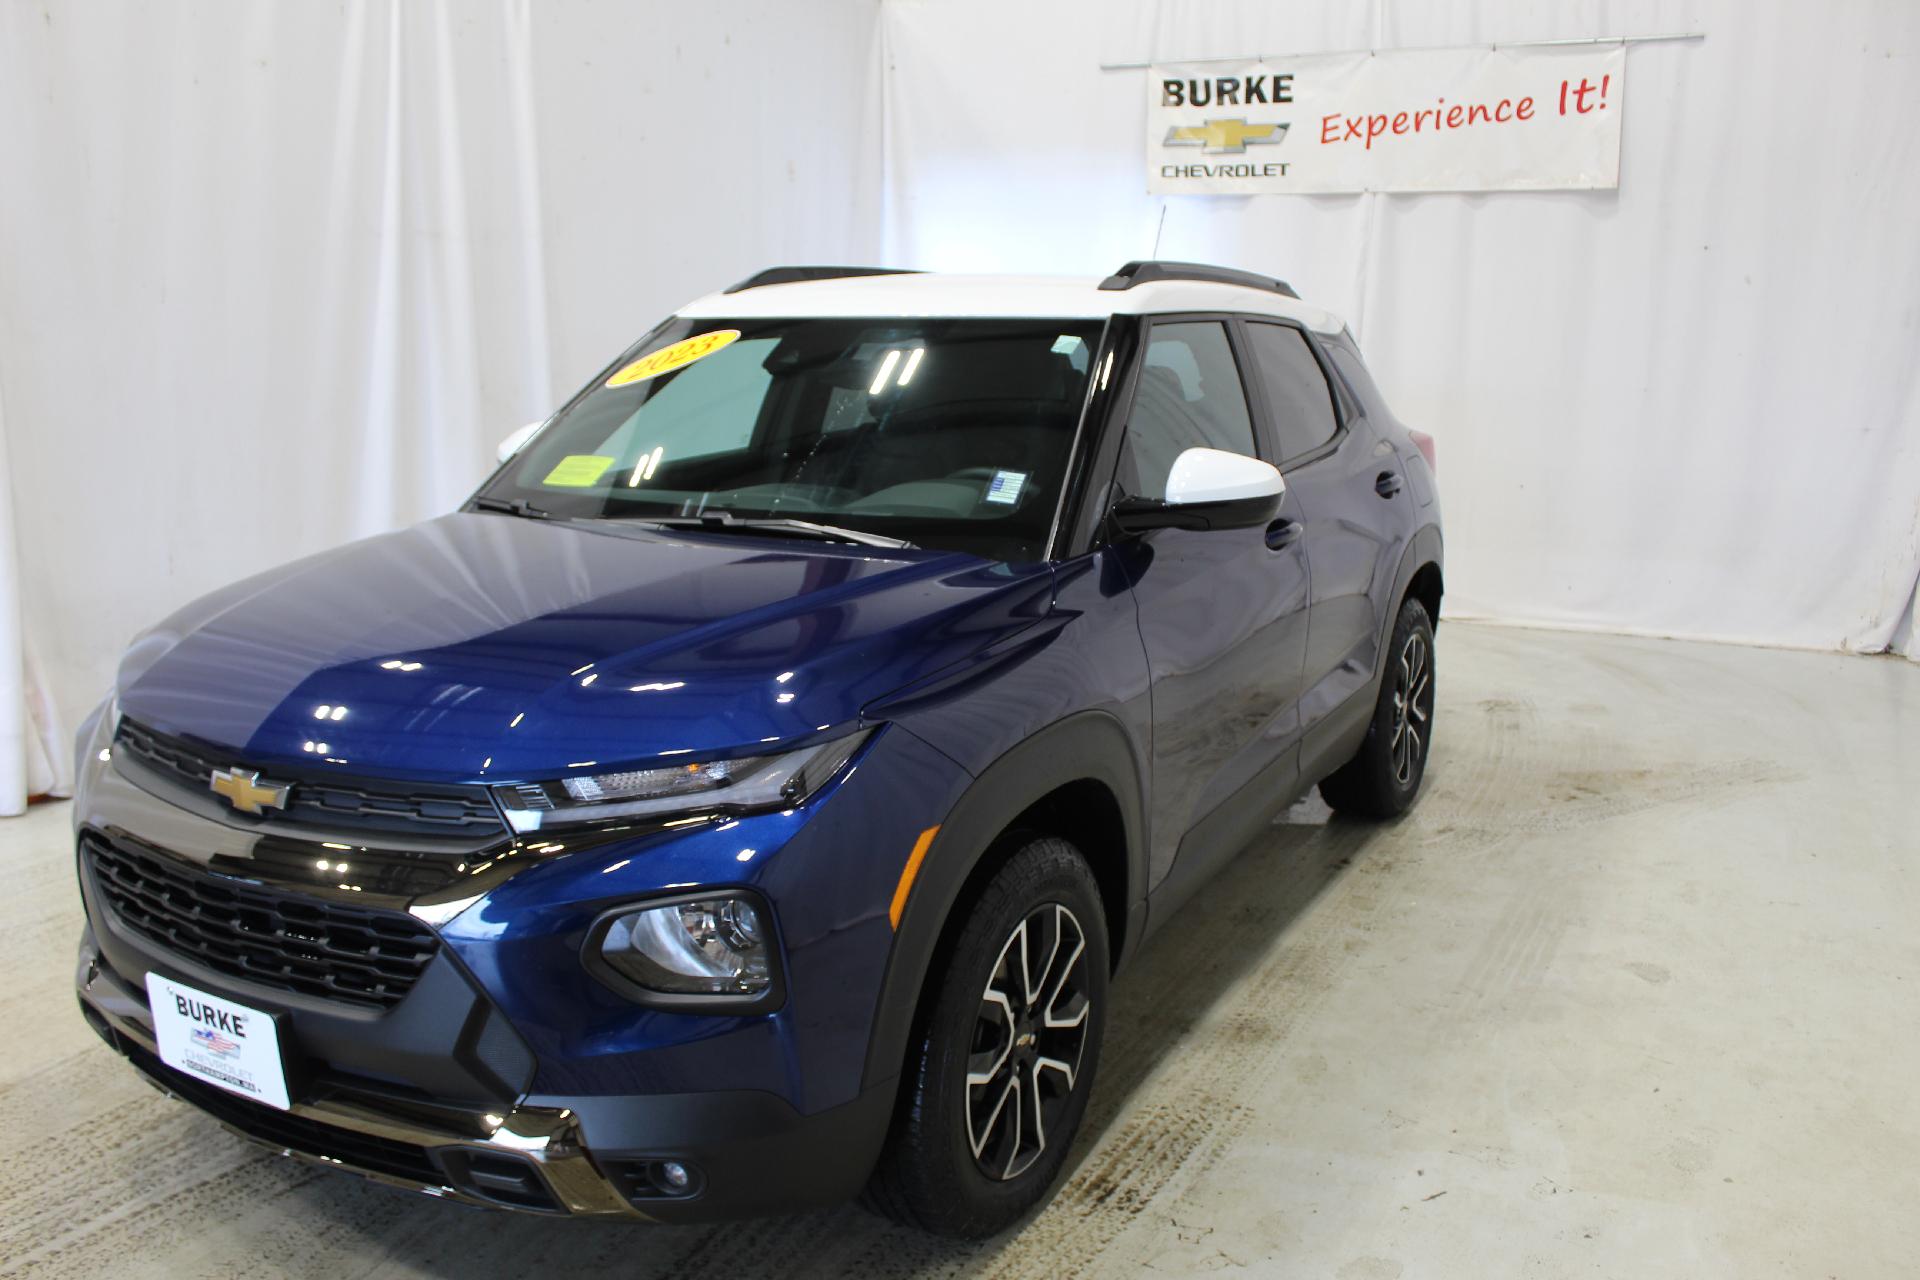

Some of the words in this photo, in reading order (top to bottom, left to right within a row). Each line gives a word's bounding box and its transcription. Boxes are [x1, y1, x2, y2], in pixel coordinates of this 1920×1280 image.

[1162, 74, 1293, 106] BURKE
[1320, 97, 1535, 150] Experience
[1559, 75, 1610, 116] It!
[1162, 163, 1290, 177] CHEVROLET
[627, 335, 719, 380] 2023
[176, 994, 247, 1038] BURKE
[184, 1049, 255, 1081] CHEVROLET
